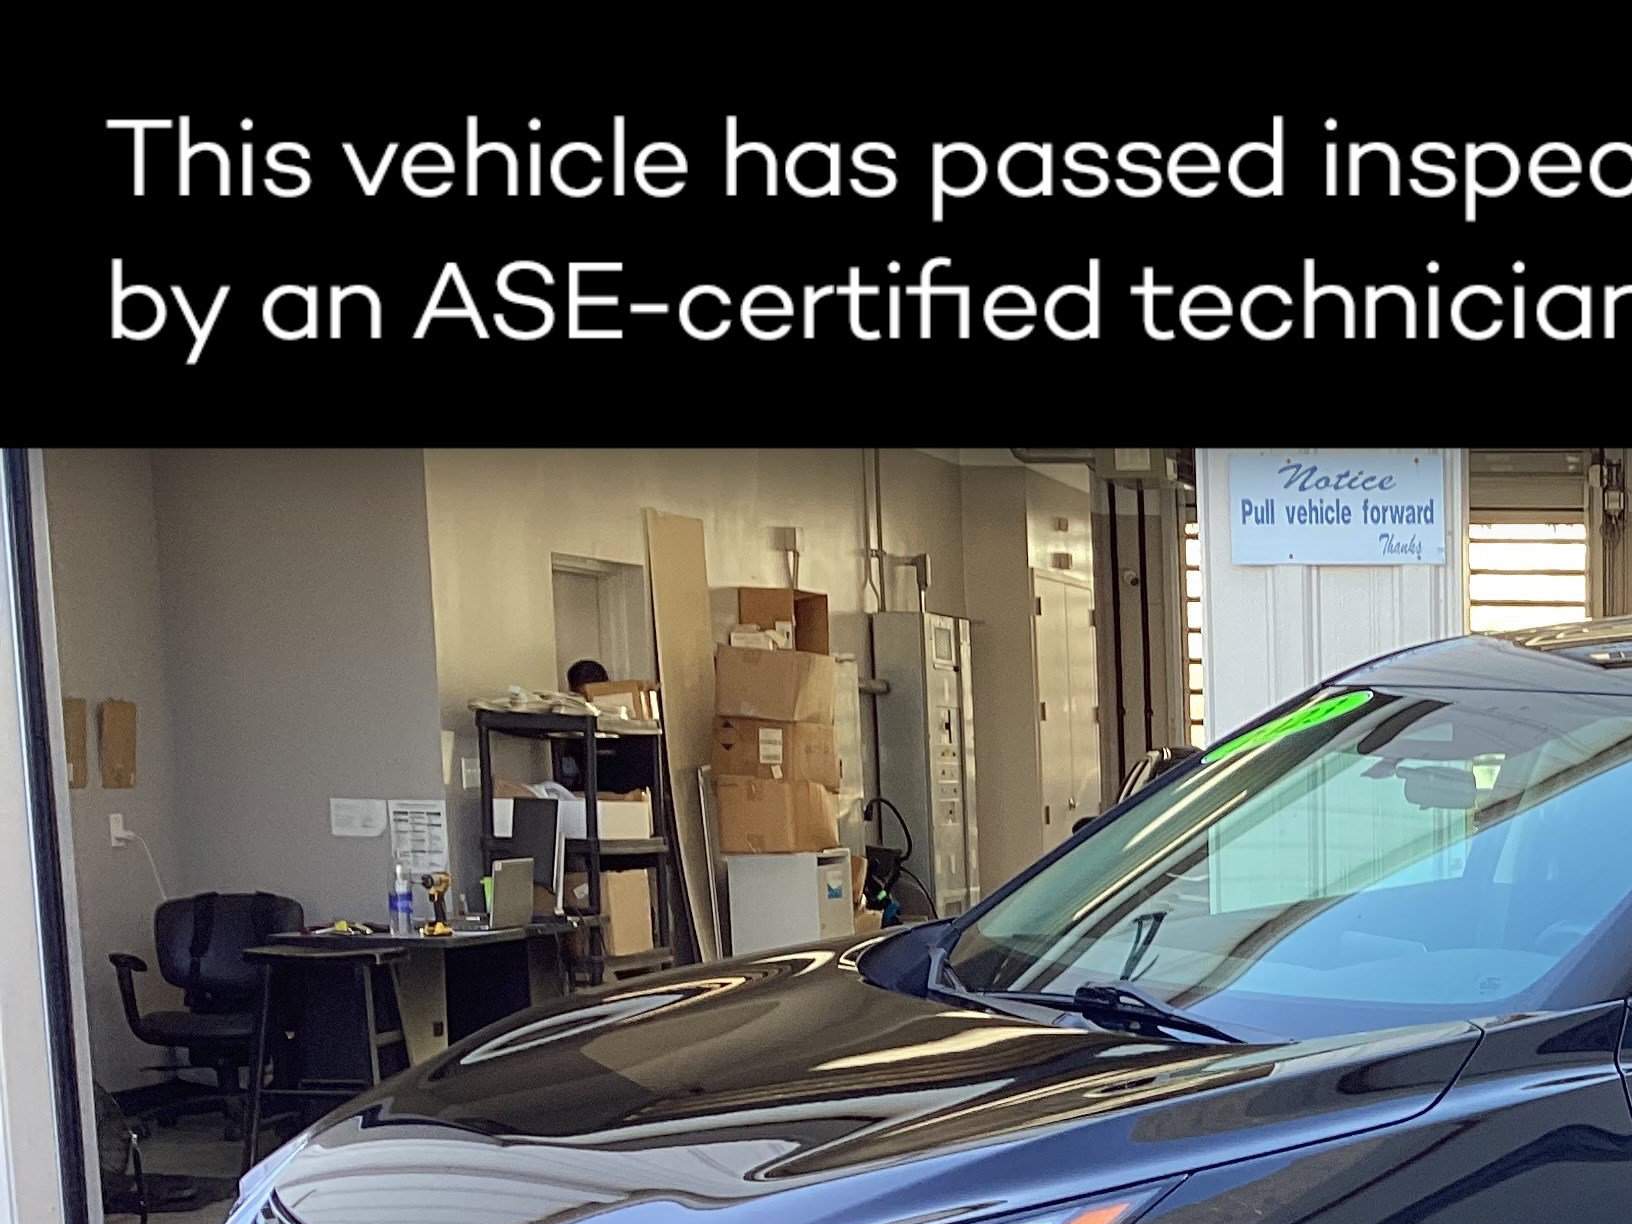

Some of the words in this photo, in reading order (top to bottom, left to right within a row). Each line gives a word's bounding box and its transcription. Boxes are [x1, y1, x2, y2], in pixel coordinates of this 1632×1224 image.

[1277, 463, 1397, 492] Notice
[1241, 499, 1275, 525] Pull
[1285, 499, 1351, 525] vehicle
[1362, 499, 1434, 525] forward
[1379, 533, 1422, 556] Thanks
